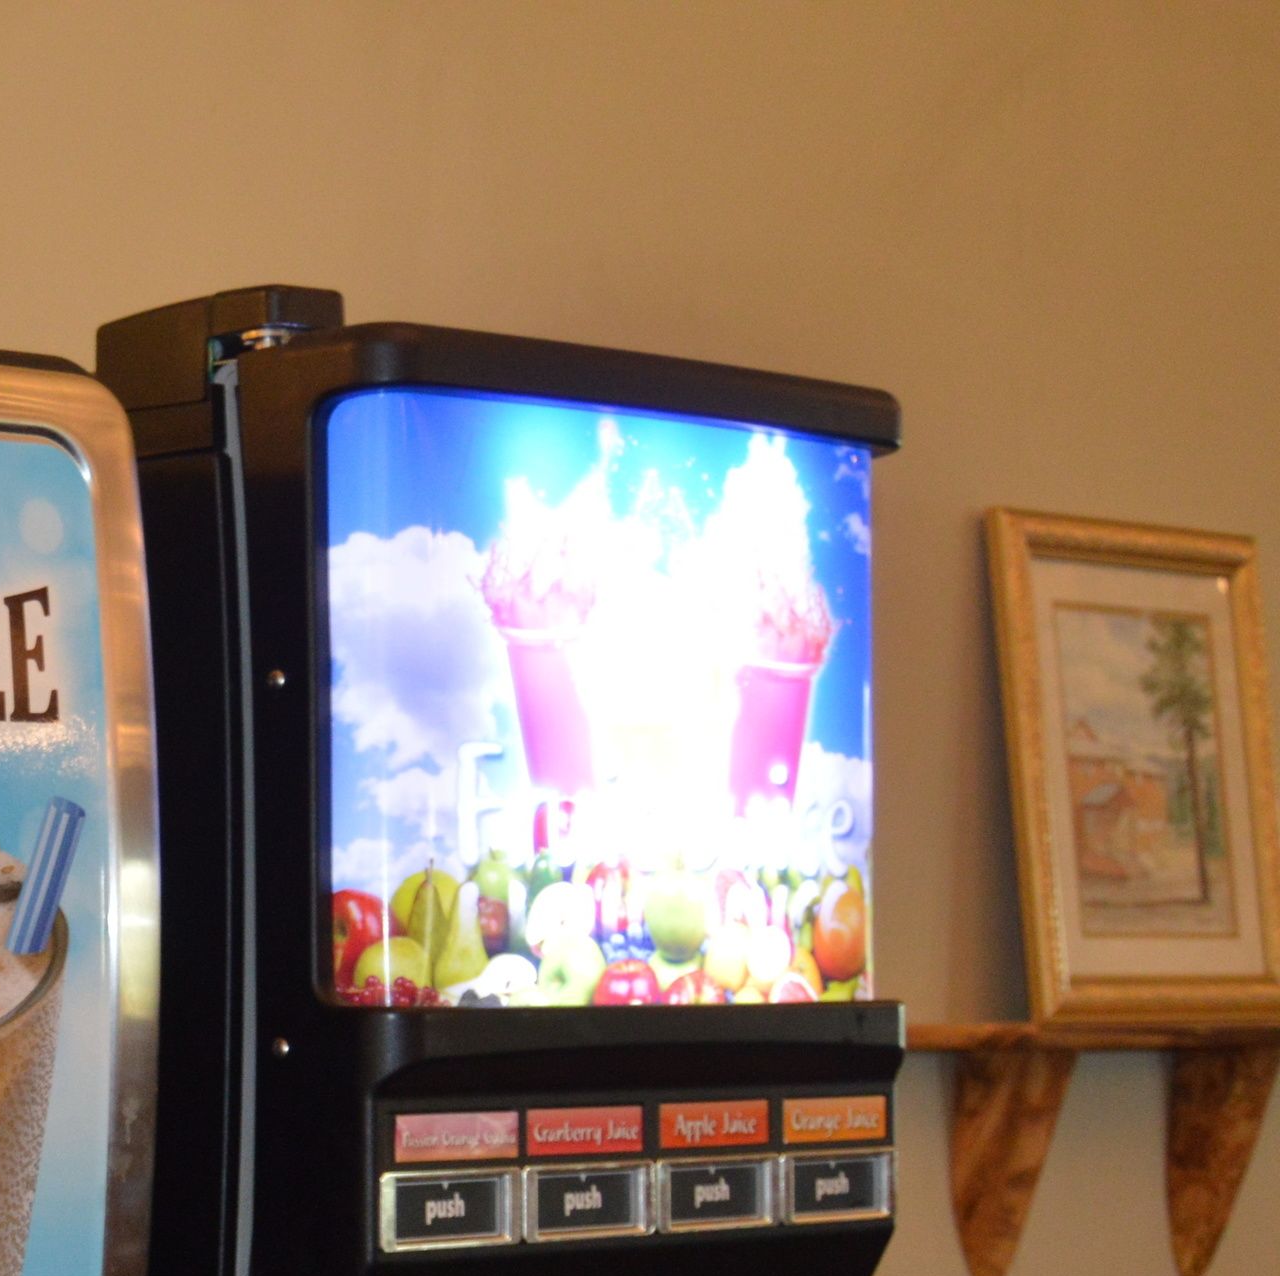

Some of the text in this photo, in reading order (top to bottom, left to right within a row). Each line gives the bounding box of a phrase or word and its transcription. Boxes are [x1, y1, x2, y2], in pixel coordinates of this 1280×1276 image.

[533, 1119, 639, 1146] Cranberry Juice
[675, 1112, 757, 1142] Apple Juice
[791, 1106, 879, 1137] Orange Juice
[563, 1184, 603, 1217] push
[694, 1176, 731, 1209] push
[815, 1170, 850, 1202] push
[425, 1191, 466, 1225] push
